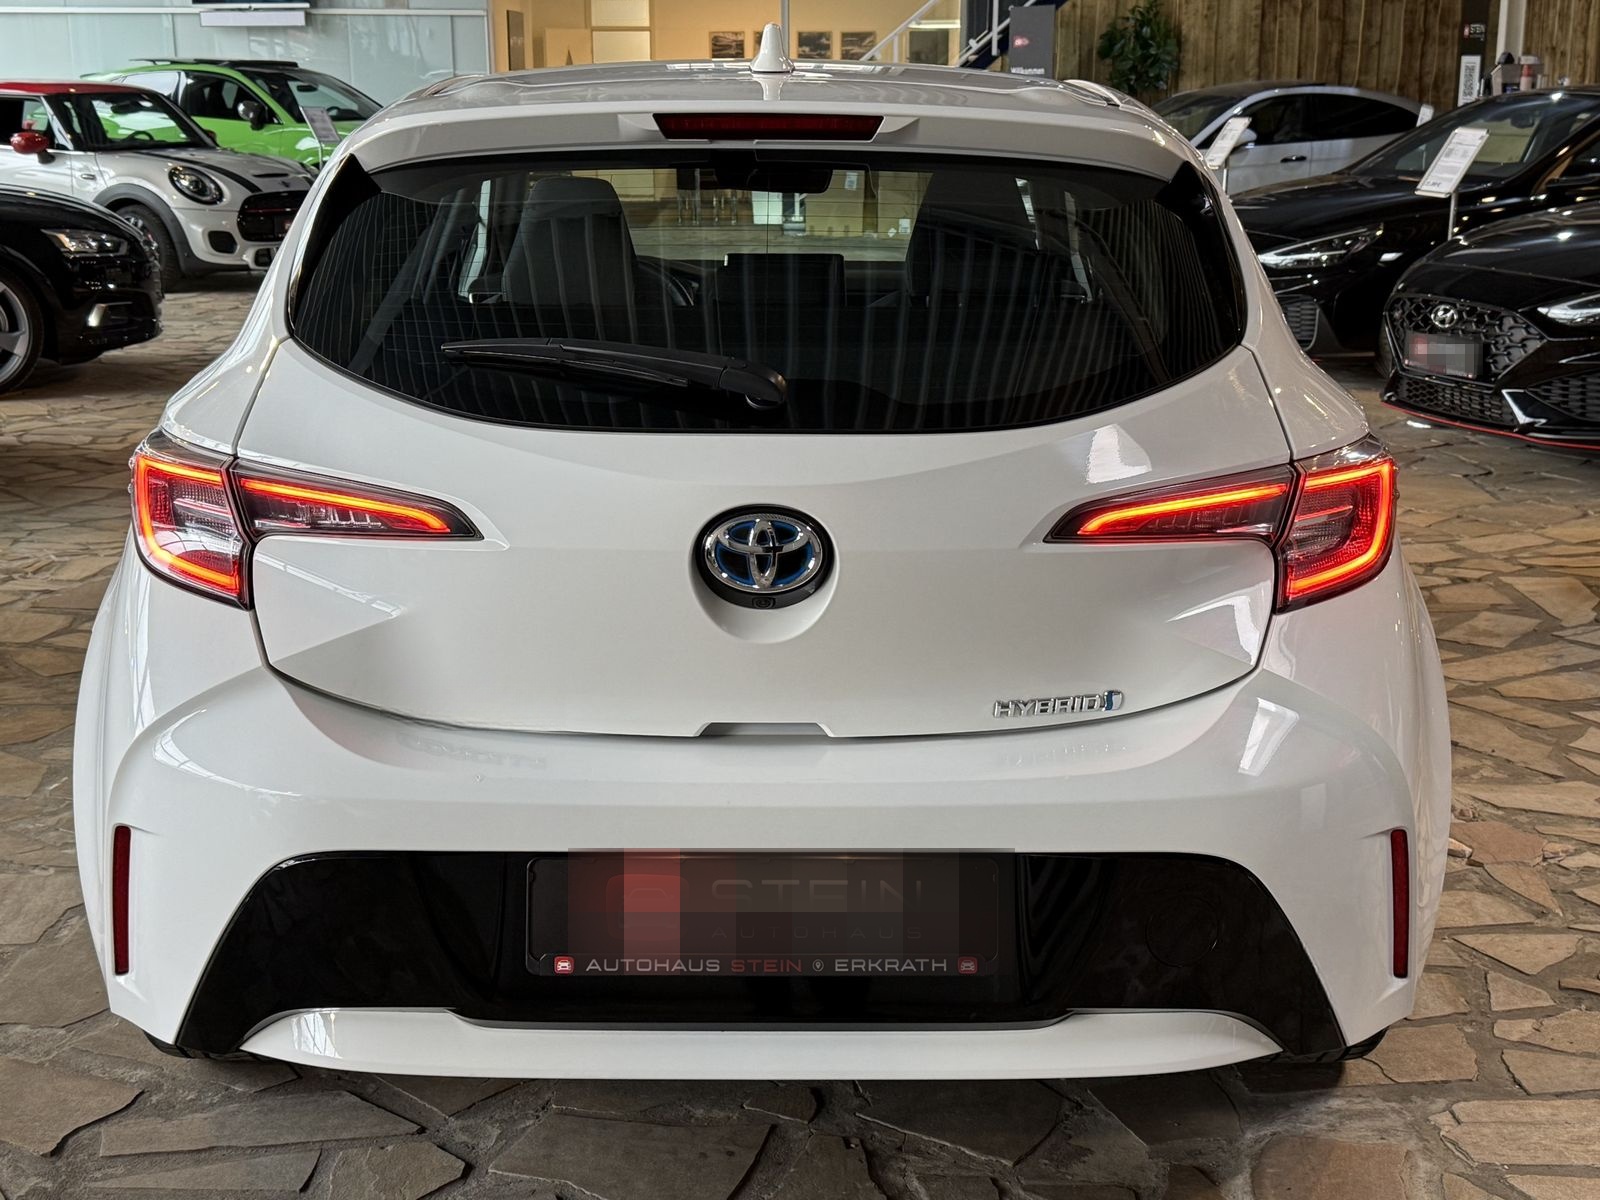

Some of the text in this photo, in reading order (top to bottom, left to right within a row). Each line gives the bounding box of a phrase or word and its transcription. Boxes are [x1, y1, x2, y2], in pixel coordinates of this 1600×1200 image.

[711, 879, 922, 913] STEIN
[711, 926, 923, 939] AUTOHAUS
[586, 958, 948, 973] AUTOHAUS STEIN ERKRATH
